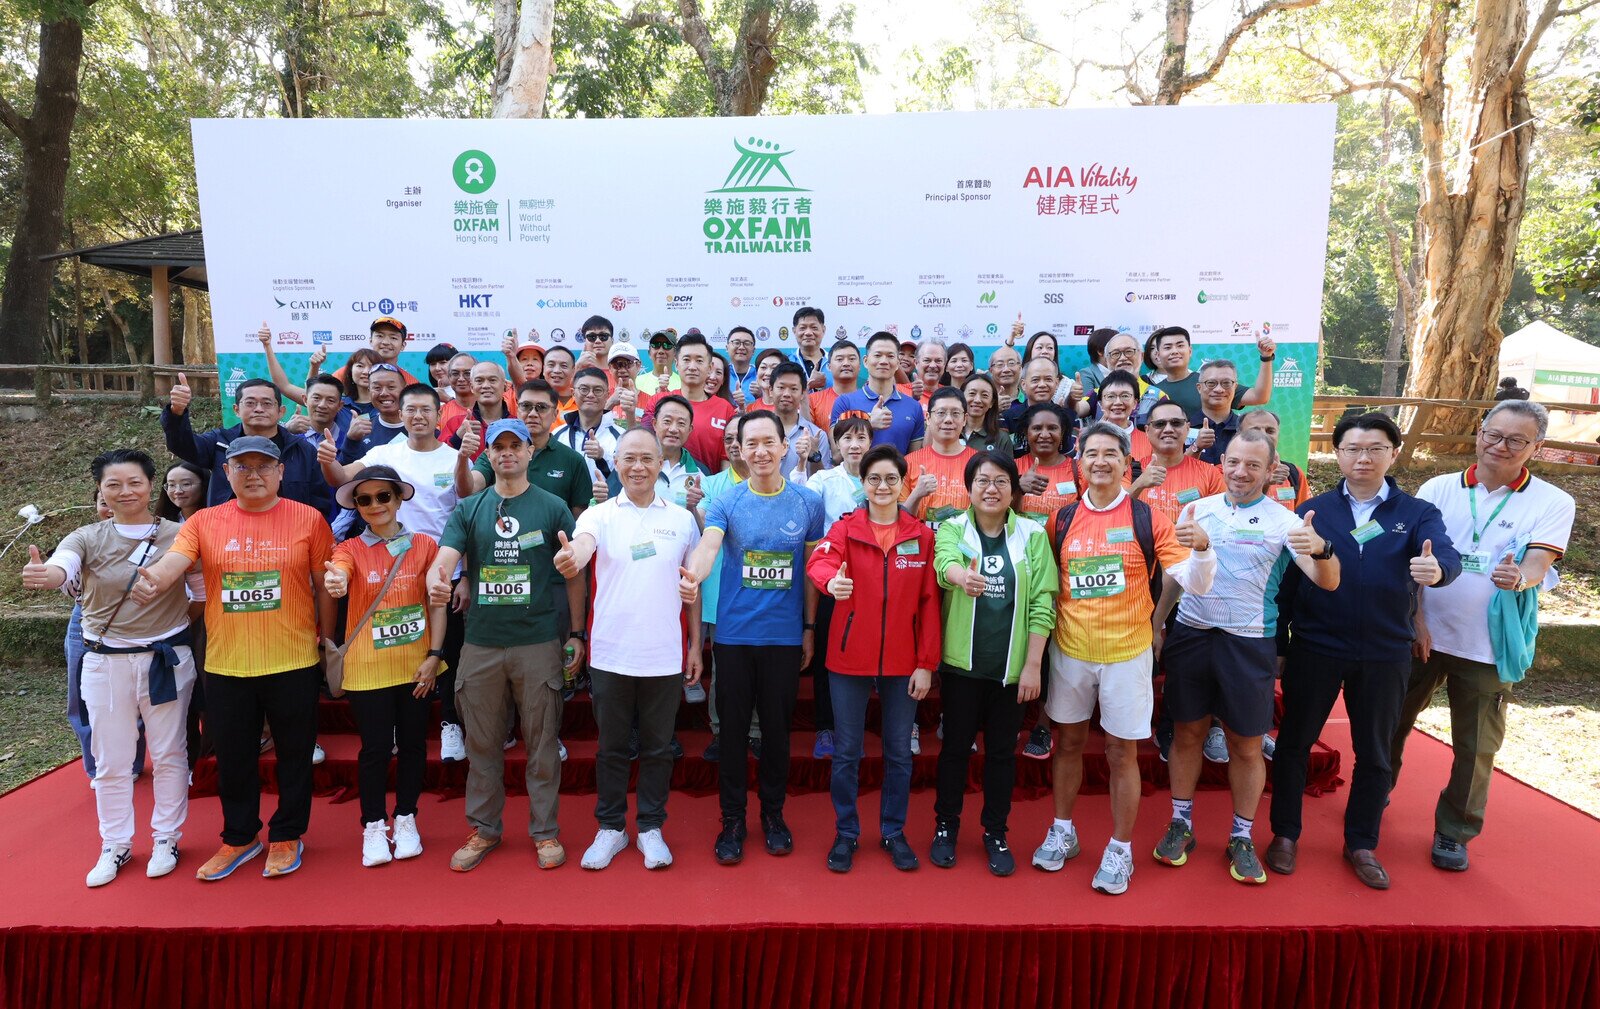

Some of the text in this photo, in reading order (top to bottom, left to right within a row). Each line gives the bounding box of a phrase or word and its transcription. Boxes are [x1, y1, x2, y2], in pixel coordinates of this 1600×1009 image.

[1023, 162, 1138, 194] AIA Vitality
[404, 186, 422, 196] 主辦
[926, 193, 991, 202] Principal Sponsor
[386, 200, 422, 208] Organiser
[454, 200, 498, 215] 樂施會
[518, 199, 555, 210] 無窮世界
[704, 197, 812, 216] 樂施毅行者
[1036, 194, 1120, 216] 健康程式
[520, 214, 542, 222] World
[454, 218, 499, 232] OXFAM
[520, 224, 550, 232] Without
[703, 217, 812, 240] OXFAM
[456, 234, 498, 244] Hong Kong
[520, 234, 550, 243] Poverty
[704, 240, 812, 254] TRAILWALKER
[460, 294, 492, 308] HKT
[546, 300, 588, 308] Columbia
[1044, 294, 1064, 304] SGS
[290, 301, 333, 310] CATHAY
[352, 302, 376, 312] CLP
[397, 301, 418, 312] 中電
[1075, 326, 1093, 335] Fitz
[750, 567, 785, 579] L001
[1076, 574, 1117, 588] L002
[486, 583, 524, 594] L006
[230, 589, 274, 602] L065
[380, 621, 419, 638] L003
